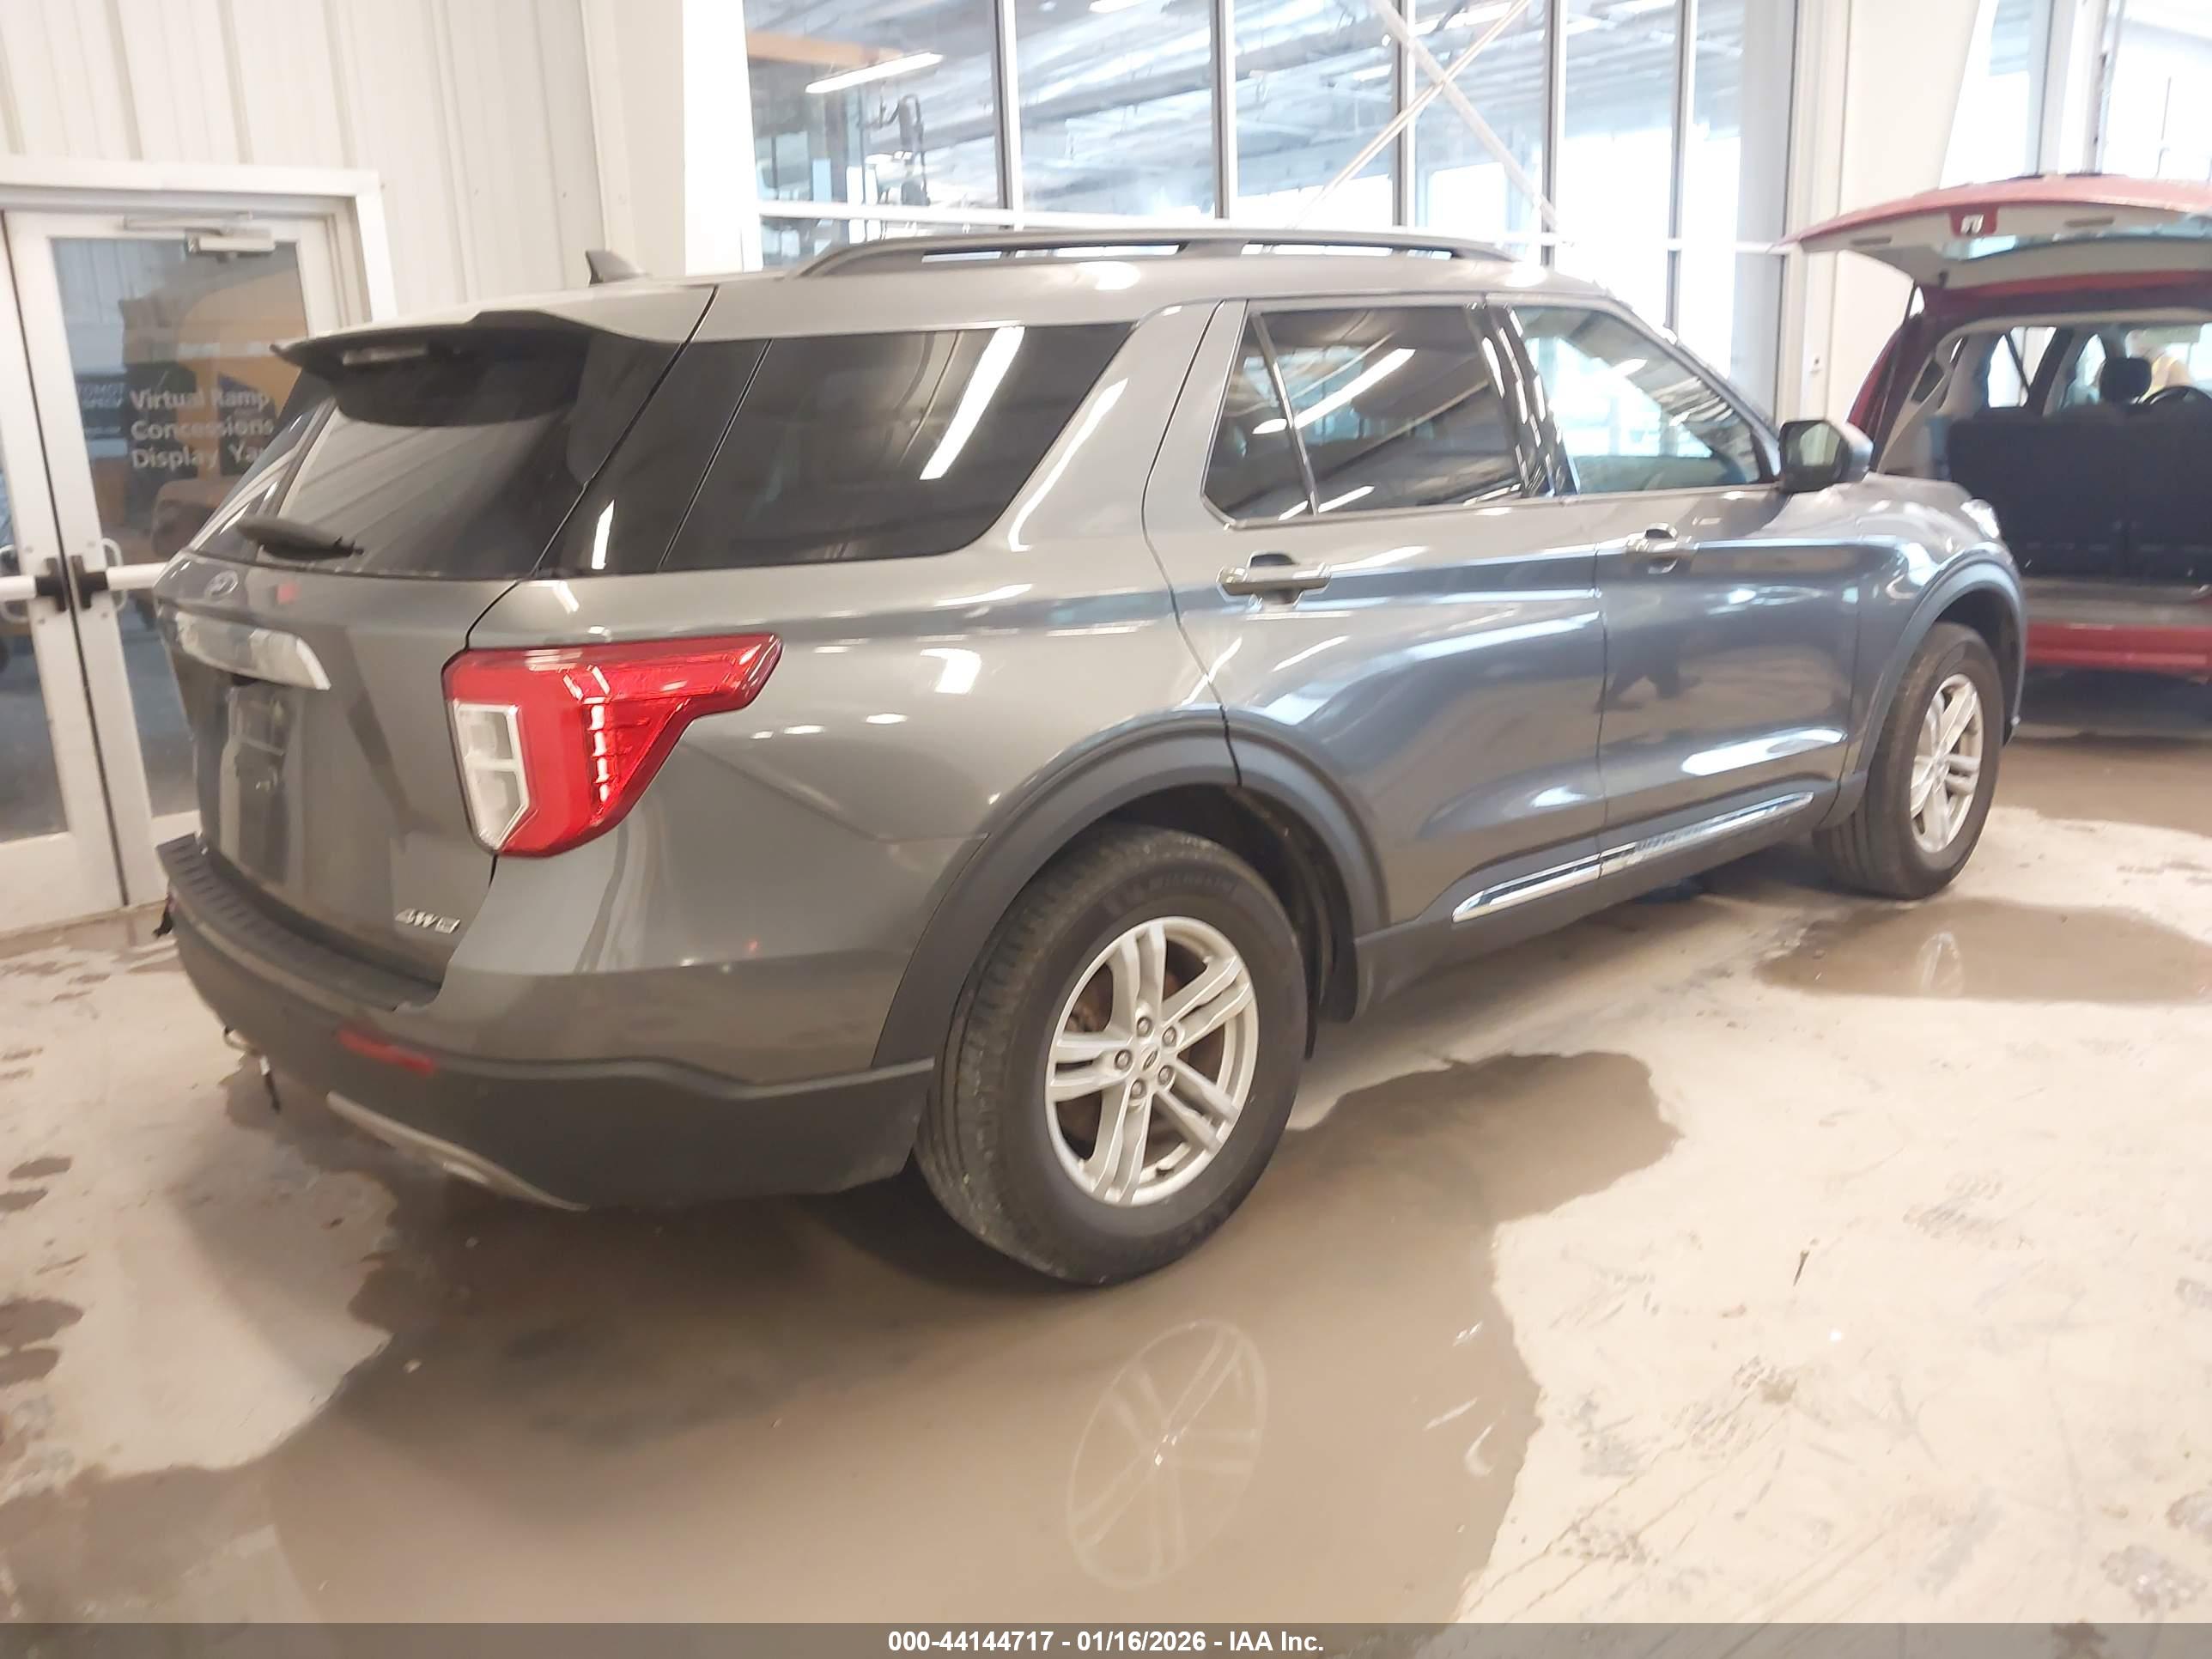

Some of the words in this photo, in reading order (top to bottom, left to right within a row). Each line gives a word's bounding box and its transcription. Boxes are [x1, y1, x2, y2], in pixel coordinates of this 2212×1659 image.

[130, 388, 205, 410] Virtual
[212, 388, 270, 410] Ramp
[131, 416, 275, 441] Concessions
[131, 445, 219, 469] Display
[395, 908, 461, 934] 4WD
